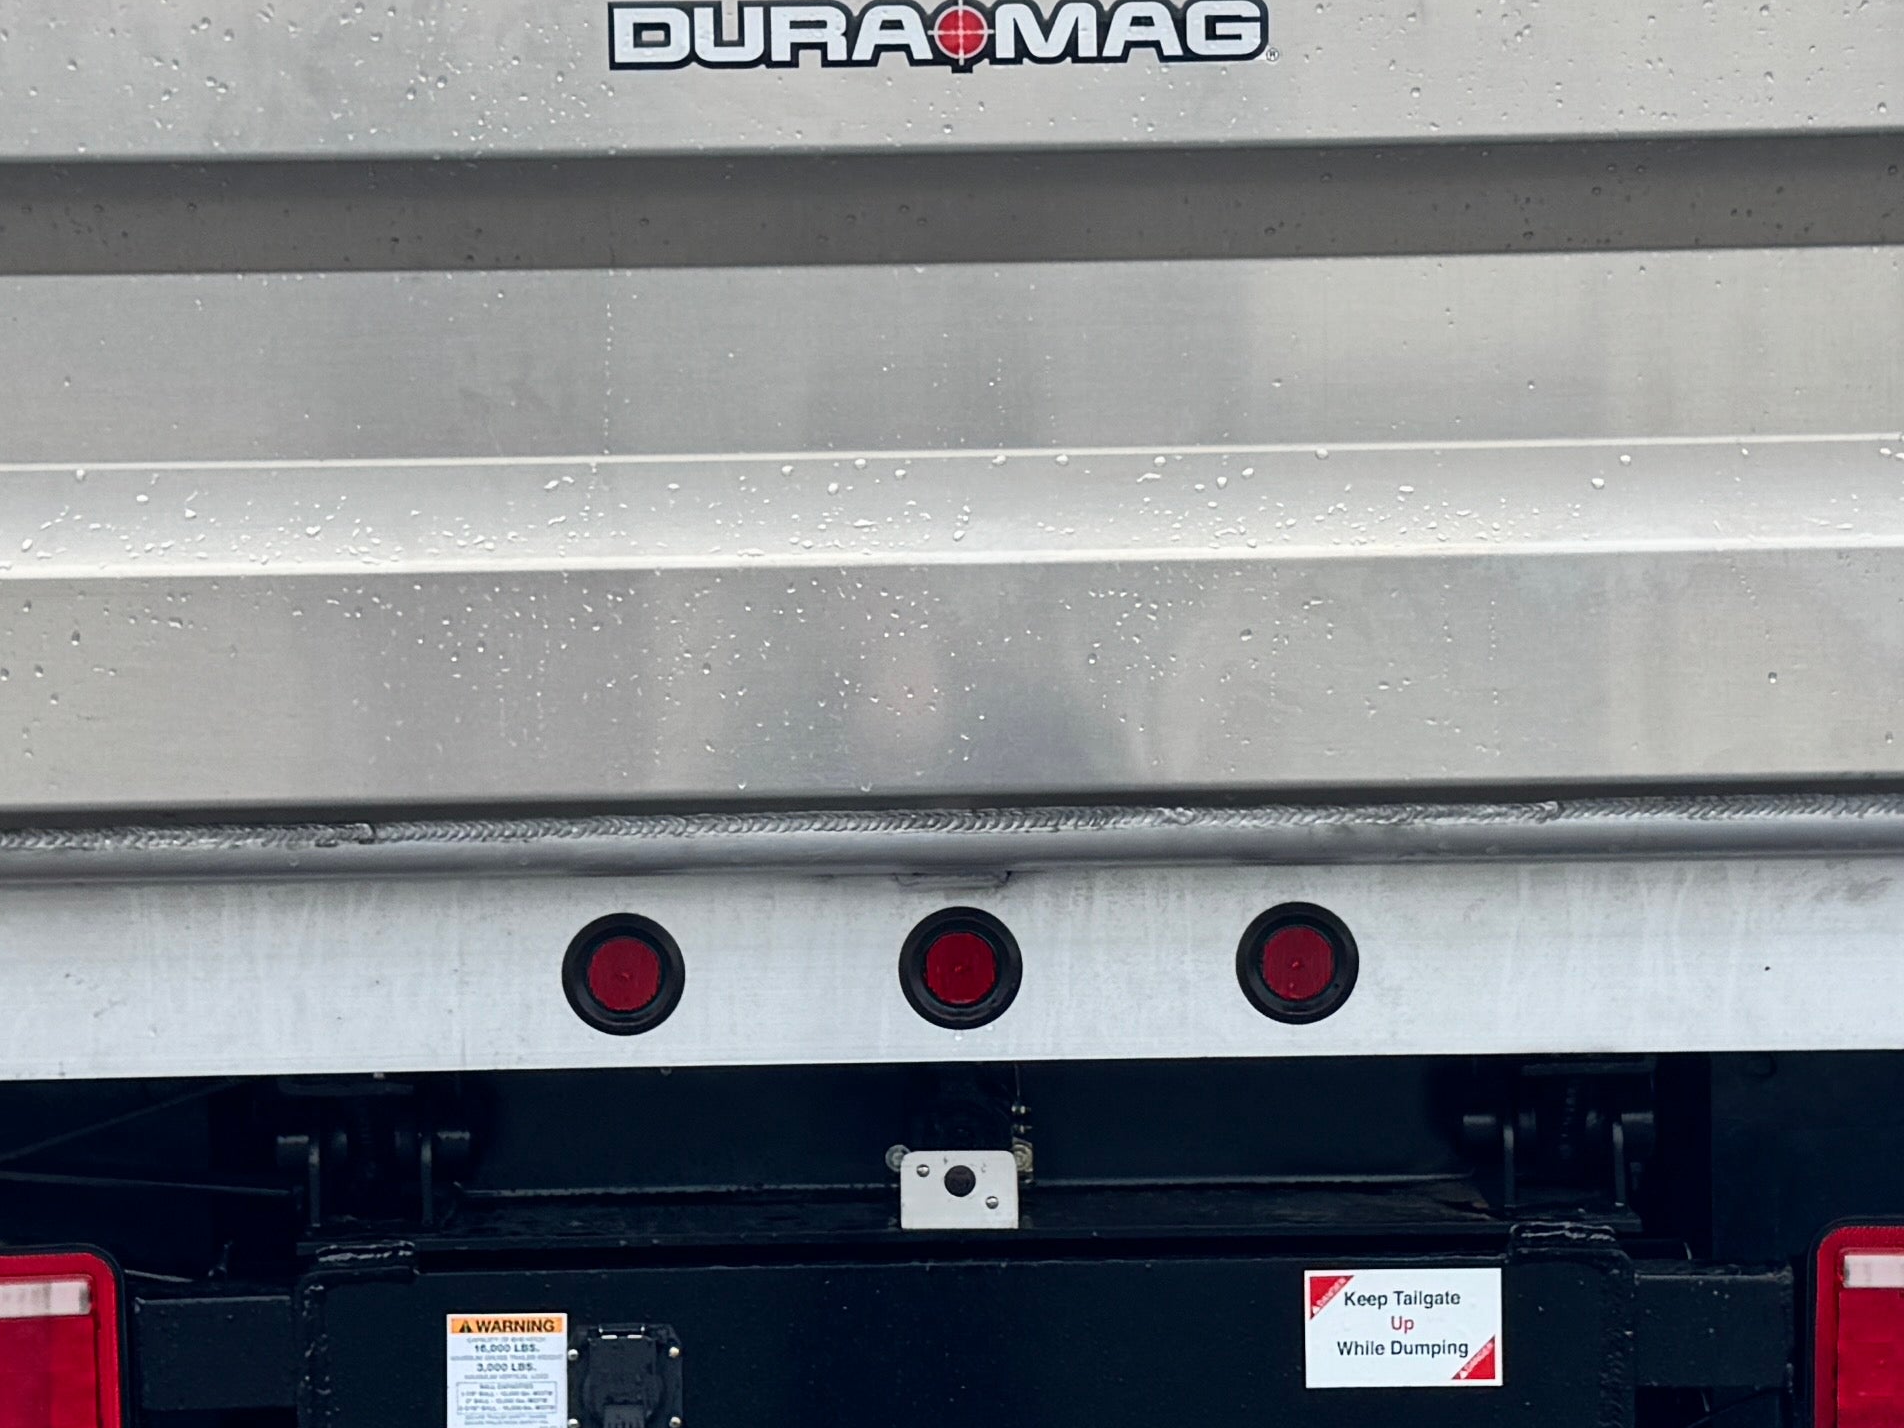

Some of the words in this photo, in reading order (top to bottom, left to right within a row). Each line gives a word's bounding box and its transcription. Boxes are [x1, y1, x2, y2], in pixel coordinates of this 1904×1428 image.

[1344, 1291, 1388, 1310] Keep
[1393, 1289, 1461, 1310] Tailgate
[475, 1319, 555, 1333] WARNING
[1390, 1315, 1415, 1335] Up
[1337, 1340, 1385, 1357] While
[1391, 1339, 1469, 1359] Dumping
